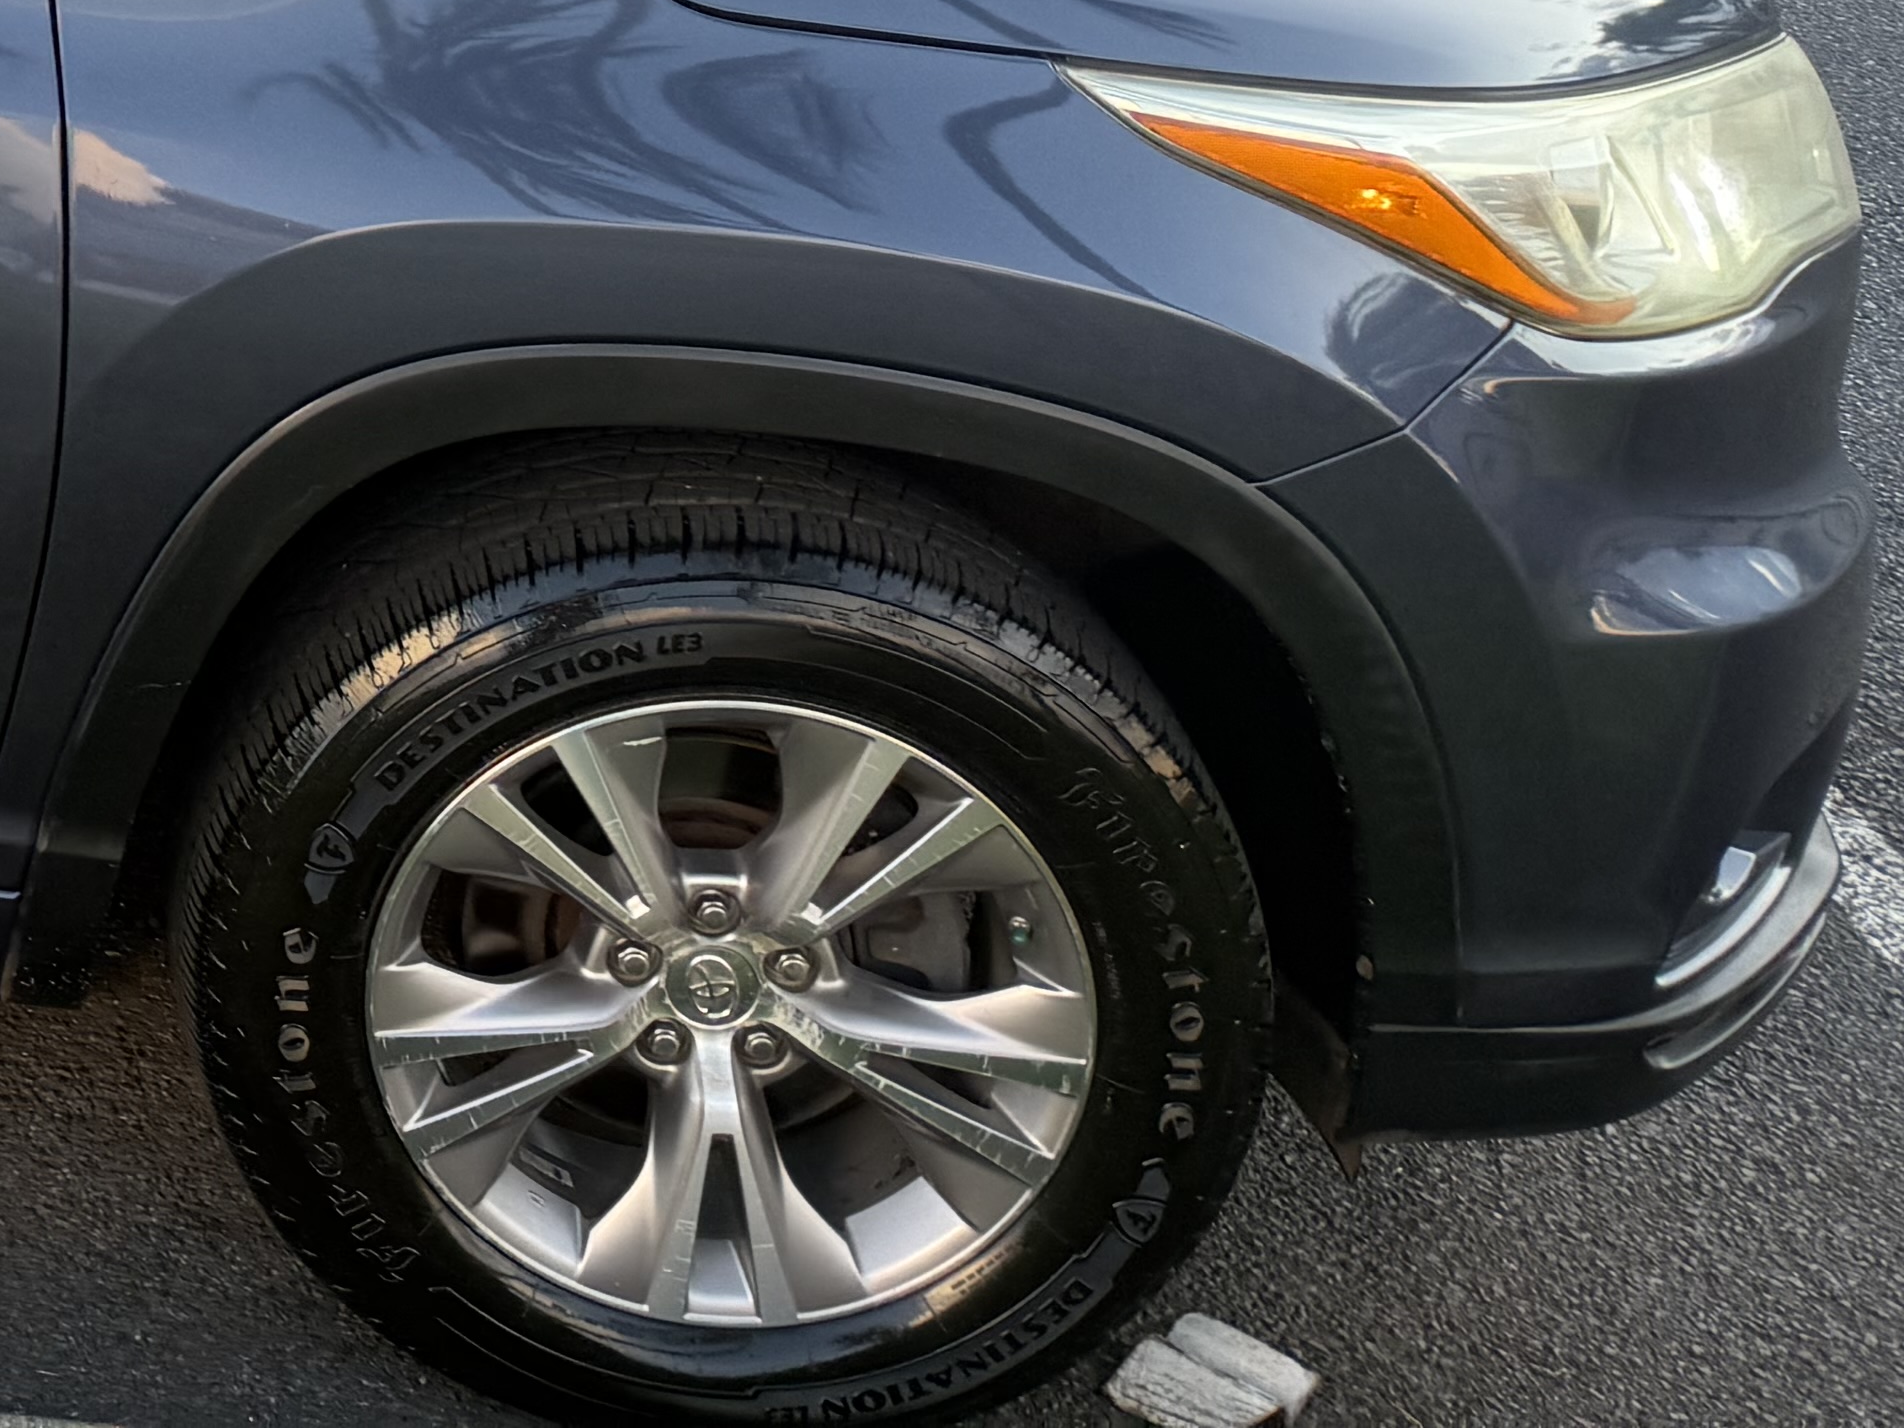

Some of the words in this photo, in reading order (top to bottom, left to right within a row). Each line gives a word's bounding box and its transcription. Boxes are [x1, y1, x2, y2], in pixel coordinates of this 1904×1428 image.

[373, 640, 649, 792] DESTINATION
[654, 631, 705, 656] LE3
[1057, 766, 1210, 1141] Firestone
[271, 926, 422, 1284] Firestone
[820, 1275, 1095, 1424] DESTINATION
